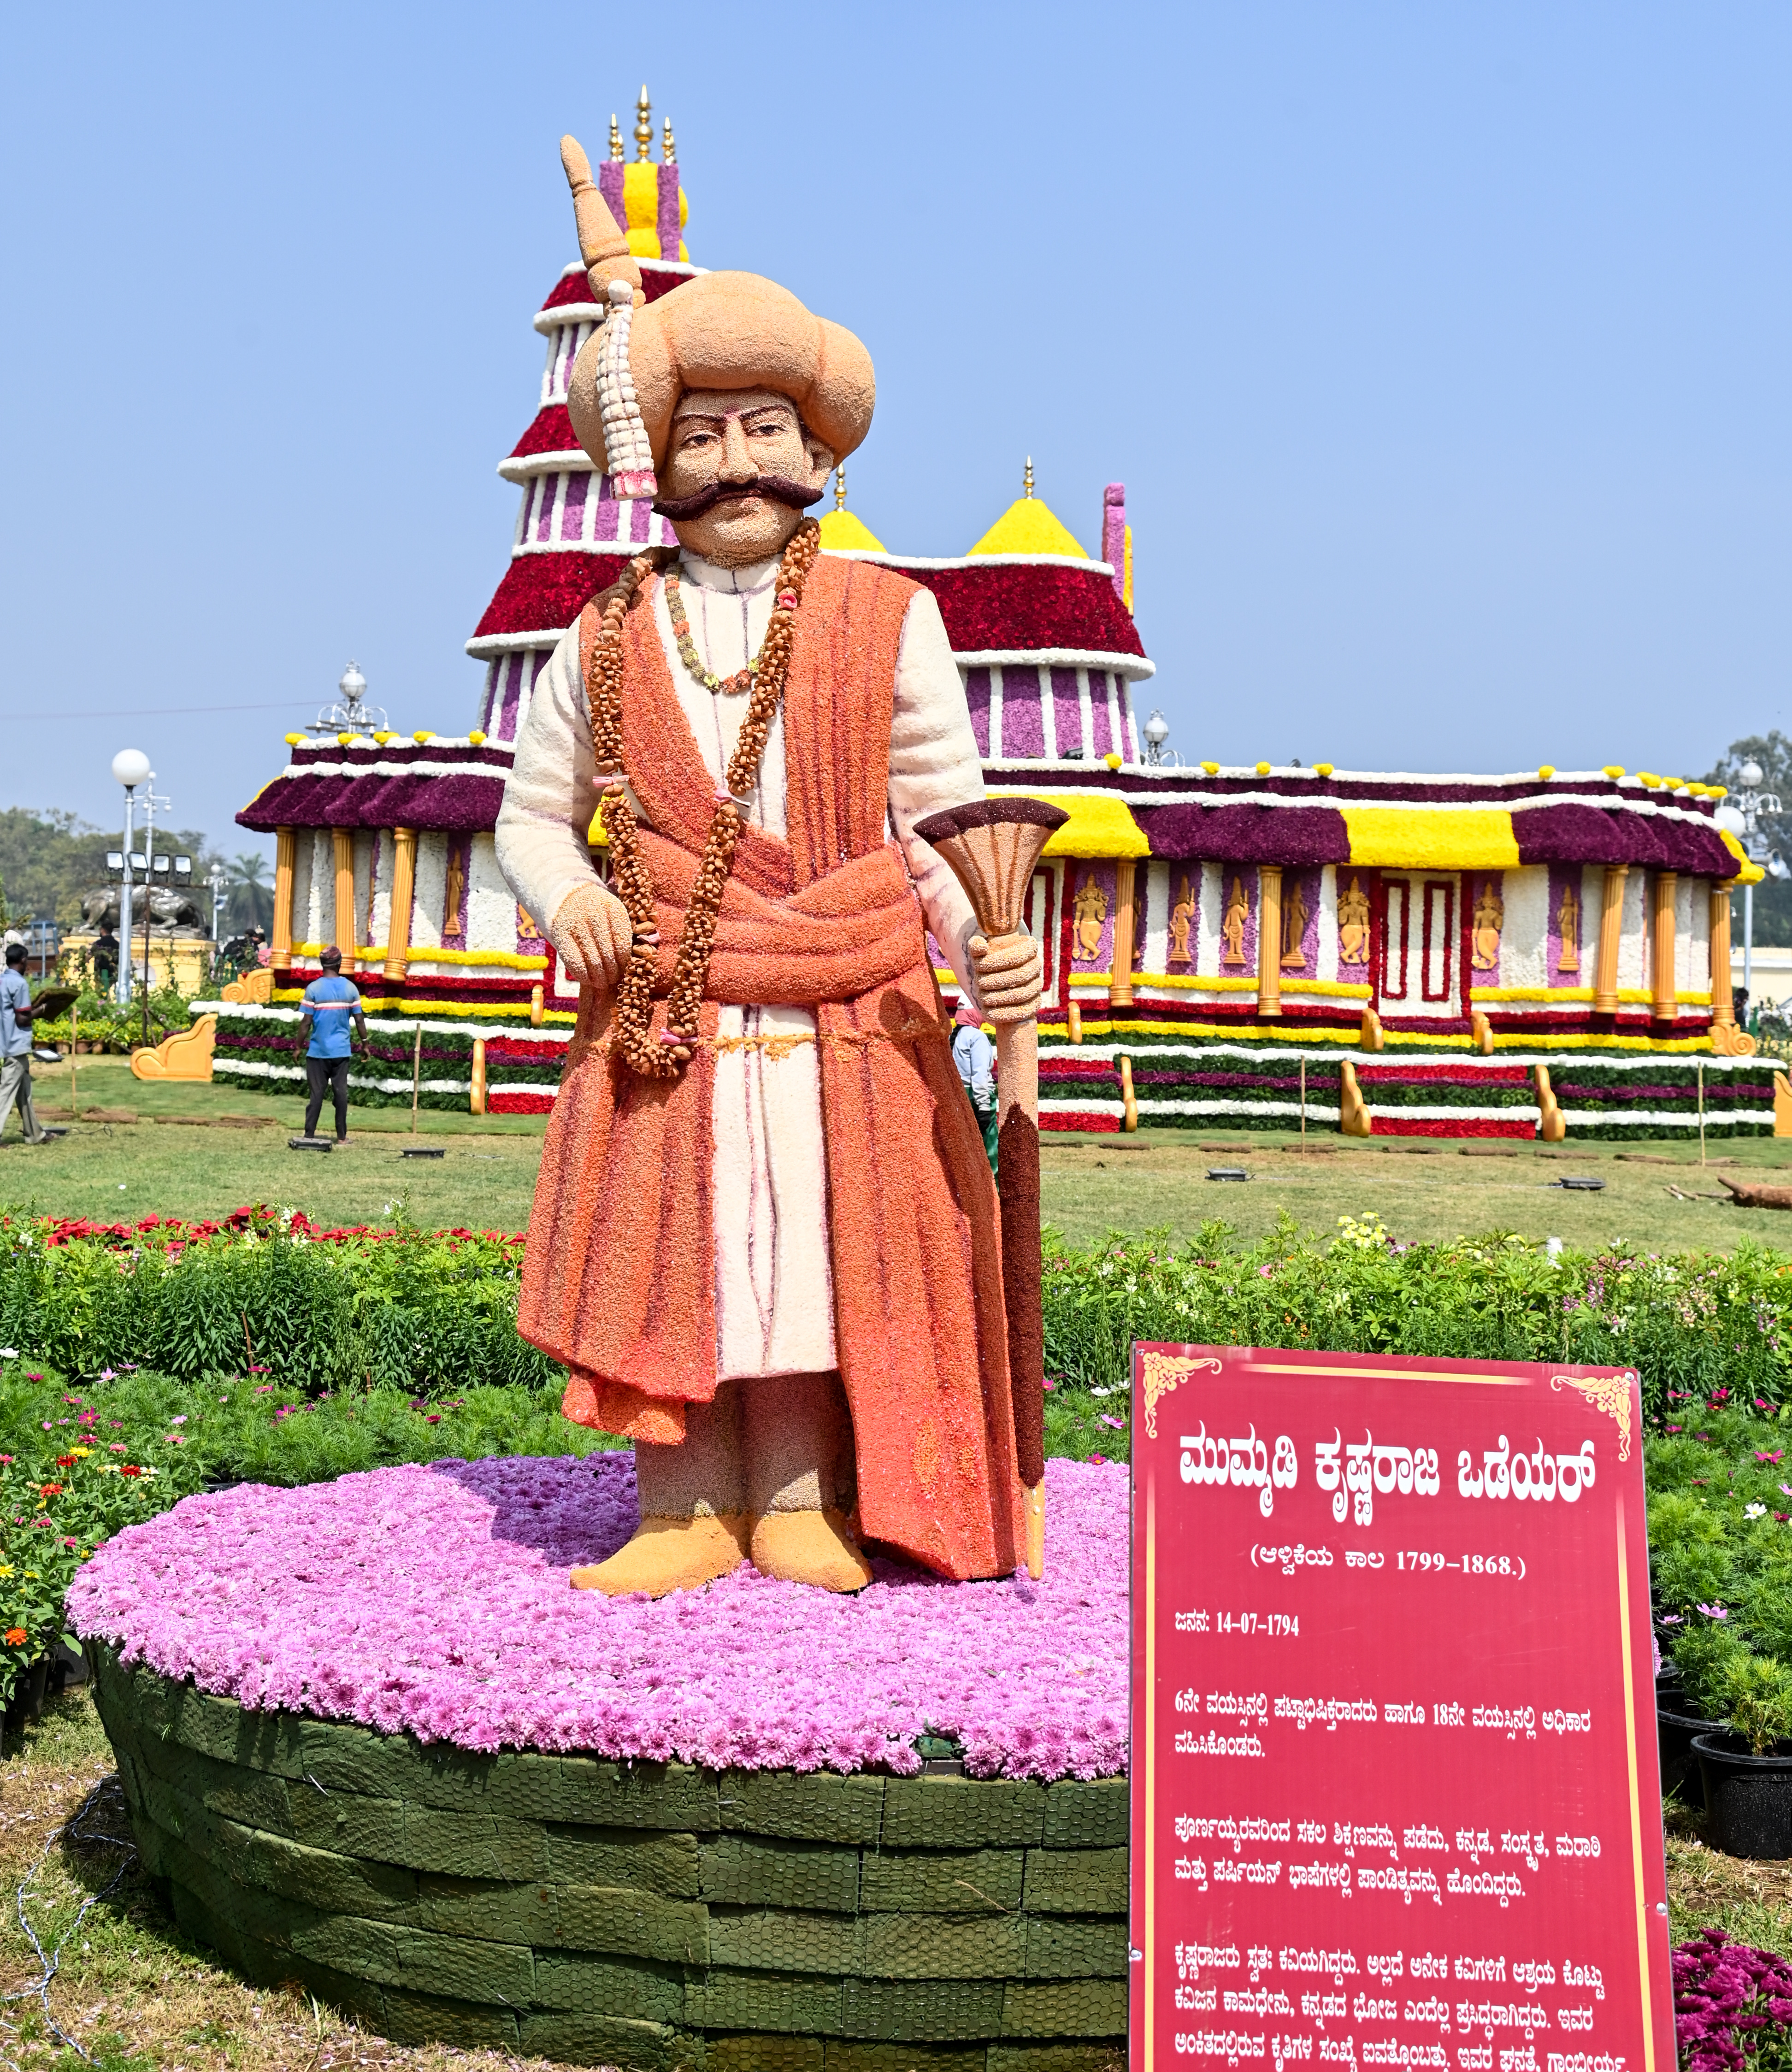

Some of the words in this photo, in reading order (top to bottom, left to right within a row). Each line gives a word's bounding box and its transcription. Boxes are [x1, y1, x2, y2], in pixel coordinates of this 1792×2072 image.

[1179, 1419, 1298, 1518] ಮುಮ್ಮಡಿ
[1315, 1426, 1440, 1526] ಕೃಷ್ಣರಾಜ
[1457, 1434, 1596, 1503] ಒಡೆಯರ್
[1250, 1543, 1334, 1576] (ಆಳ್ವಿಕೆಯ
[1344, 1551, 1385, 1569] ಕಾಲ
[1174, 1608, 1210, 1633] ಜನನ:
[1174, 1688, 1200, 1713] 6ನೇ
[1206, 1690, 1269, 1727] ವಯಸ್ಸಿನಲ್ಲಿ
[1273, 1694, 1378, 1731] ಪಟ್ಟಾಭಿಷಿಕ್ತರಾದರು
[1384, 1700, 1426, 1725] ಹಾಗೂ
[1432, 1701, 1466, 1727] 18ನೇ
[1472, 1703, 1537, 1741] ವಯಸ್ಸಿನಲ್ಲಿ
[1542, 1708, 1592, 1736] ಅಧಿಕಾರ
[1174, 1730, 1266, 1758] ವಹಿಸಿಕೊಂಡರು.
[1174, 1812, 1291, 1854] ಪೂರ್ಣಯ್ಯರವರಿಂದ
[1296, 1819, 1327, 1844] ಸಕಲ
[1332, 1821, 1399, 1861] ಶಿಕ್ಷಣವನ್ನು
[1403, 1823, 1450, 1853] ಪಡೆದು,
[1455, 1826, 1495, 1866] ಕನ್ನಡ,
[1500, 1829, 1550, 1872] ಸಂಸ್ಕೃತ,
[1555, 1832, 1602, 1858] ಮರಾಠಿ
[1174, 1854, 1208, 1892] ಮತ್ತು
[1213, 1856, 1283, 1885] ಪರ್ಷಿಯನ್
[1288, 1860, 1353, 1898] ಭಾಷೆಗಳಲ್ಲಿ
[1357, 1866, 1443, 1906] ಪಾಂಡಿತ್ಯವನ್ನು
[1446, 1867, 1526, 1908] ಹೊಂದಿದ್ದರು.
[1174, 1940, 1241, 1980] ಕೃಷ್ಣರಾಜರು
[1247, 1944, 1273, 1983] ಸ್ವತಃ
[1367, 1950, 1404, 1987] ಅಲ್ಲದೆ
[1409, 1952, 1449, 1979] ಅನೇಕ
[1454, 1954, 1507, 1982] ಕವಿಗಳಿಗೆ
[1512, 1959, 1556, 1994] ಆಶ್ರಯ
[1562, 1959, 1606, 2001] ಕೊಟ್ಟು
[1174, 1984, 1217, 2012] ಕವಿಜನ
[1223, 1986, 1295, 2018] ಕಾಮಧೇನು,
[1300, 1990, 1347, 2031] ಕನ್ನಡದ
[1353, 1991, 1398, 2023] ಭೋಜ
[1403, 1995, 1451, 2034] ಎಂದೆಲ್ಲ
[1557, 2005, 1594, 2032] ಇವರ
[1174, 2029, 1265, 2067] ಅಂಕಿತದಲ್ಲಿರುವ
[1271, 2032, 1313, 2072] ಕೃತಿಗಳ
[1457, 2043, 1493, 2071] ಇವರ
